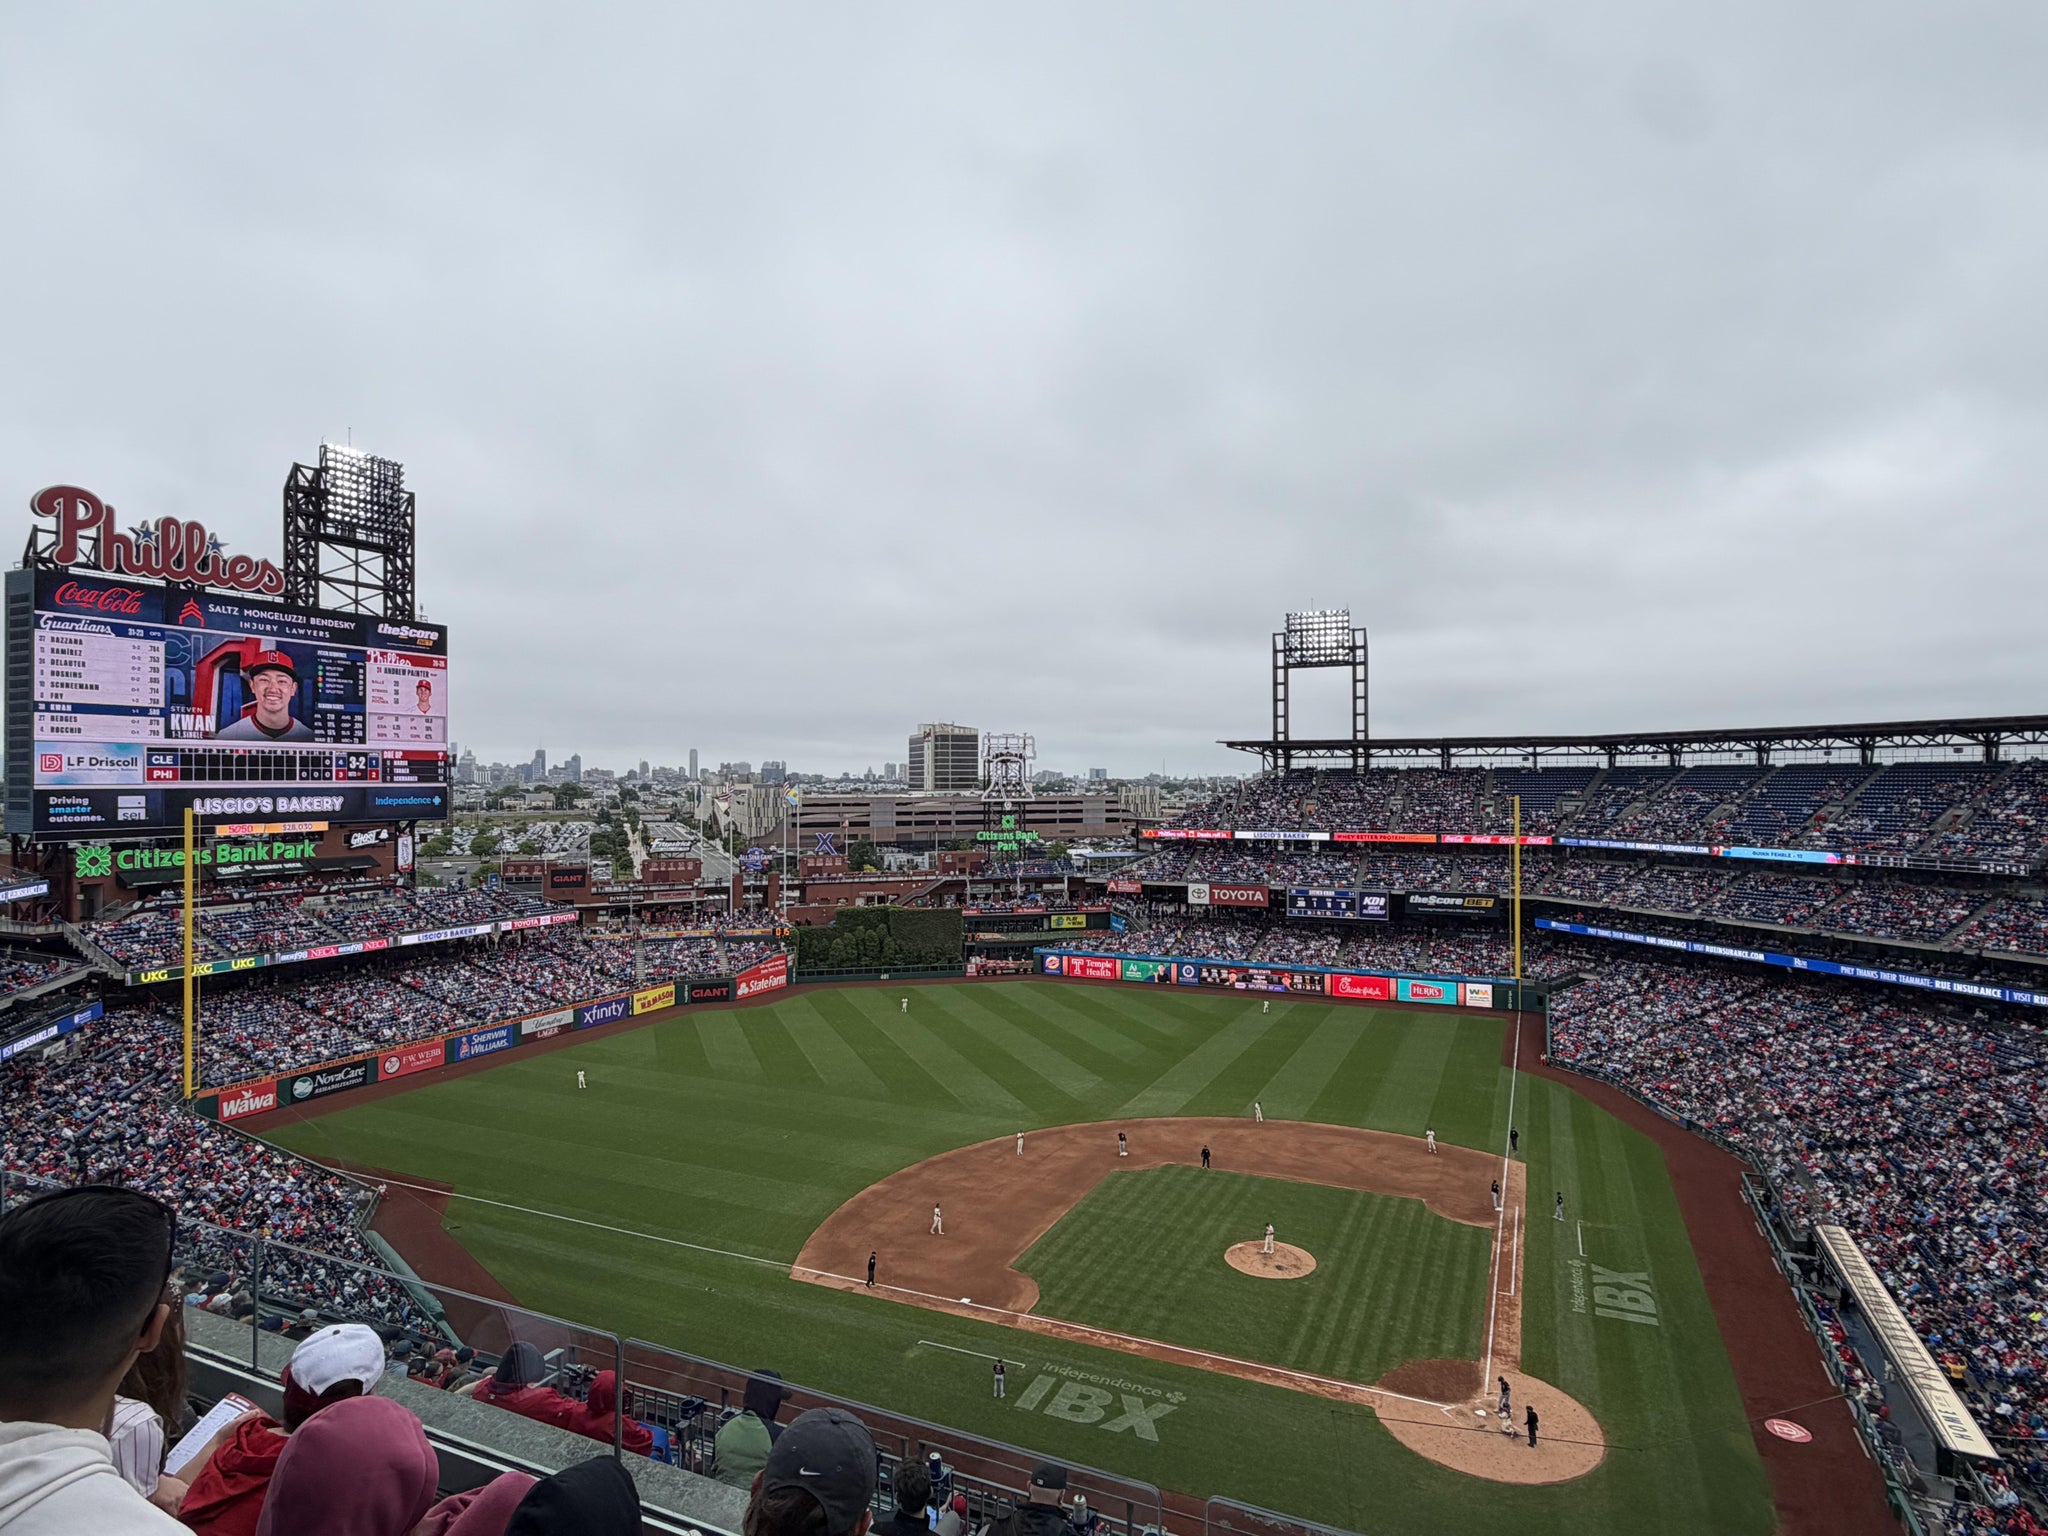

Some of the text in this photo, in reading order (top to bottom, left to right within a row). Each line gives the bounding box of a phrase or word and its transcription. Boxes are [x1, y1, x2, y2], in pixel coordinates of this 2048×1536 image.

[31, 485, 287, 596] Phillies
[55, 581, 144, 614] Coca-Cola
[208, 604, 356, 630] SALTZ MONGELUZZI BENDESKY
[40, 614, 116, 637] Guardians
[240, 621, 330, 638] INJURY LAWYERS
[378, 623, 439, 640] theScore
[367, 650, 412, 666] Phillies
[384, 667, 429, 678] ANDREW PAINTER
[170, 714, 216, 731] KWAN
[89, 756, 138, 767] Driscoll
[152, 755, 174, 764] CLE
[349, 756, 366, 769] 3-2
[153, 770, 173, 779] PHI
[49, 796, 89, 805] Driving
[193, 796, 344, 815] LISCIO'S BAKERY
[49, 806, 92, 814] smarter
[49, 815, 105, 823] outcomes.
[351, 829, 381, 846] GHOST
[976, 830, 1039, 840] Citizens Bank
[216, 842, 269, 863] Bank
[273, 839, 316, 860] Park
[997, 841, 1019, 850] Park
[1212, 889, 1264, 902] TOYOTA
[1409, 895, 1463, 905] theScore
[512, 913, 576, 929] TOYOTA TOYOTA
[450, 927, 477, 938] BAKERY
[310, 939, 388, 958] NECA NECA
[1658, 938, 1687, 949] INSURANCE
[1706, 945, 1764, 961] RUEINSURANCE.COM
[141, 958, 255, 982] UKG UKG
[1086, 960, 1112, 970] Temple
[1086, 967, 1112, 977] Health
[692, 987, 729, 998] GIANT
[1856, 968, 1879, 979] THANKS
[1880, 971, 1897, 982] THEIR
[1898, 973, 1934, 988] TEAMMATE:
[1935, 980, 1952, 990] RUE
[1953, 983, 2002, 998] INSURANCE
[2013, 991, 2032, 1002] VISIT
[583, 1002, 625, 1024] xfinity
[471, 1029, 508, 1044] SHERWIN
[537, 1027, 560, 1038] LAGER
[403, 1038, 434, 1048] ASPLUNDH
[419, 1048, 442, 1061] WEBB
[319, 1057, 355, 1069] ASPLUNDH
[271, 1067, 311, 1080] ASPLUNDH
[314, 1066, 366, 1087] NovaCare
[219, 1078, 262, 1092] ASPLUNDH
[314, 1078, 363, 1094] REHABILITATION
[222, 1093, 274, 1117] Wawa
[1591, 1263, 1660, 1326] IBX
[1042, 1362, 1162, 1397] Independence
[1014, 1374, 1178, 1442] IBX
[1935, 1407, 1976, 1441] HOME
